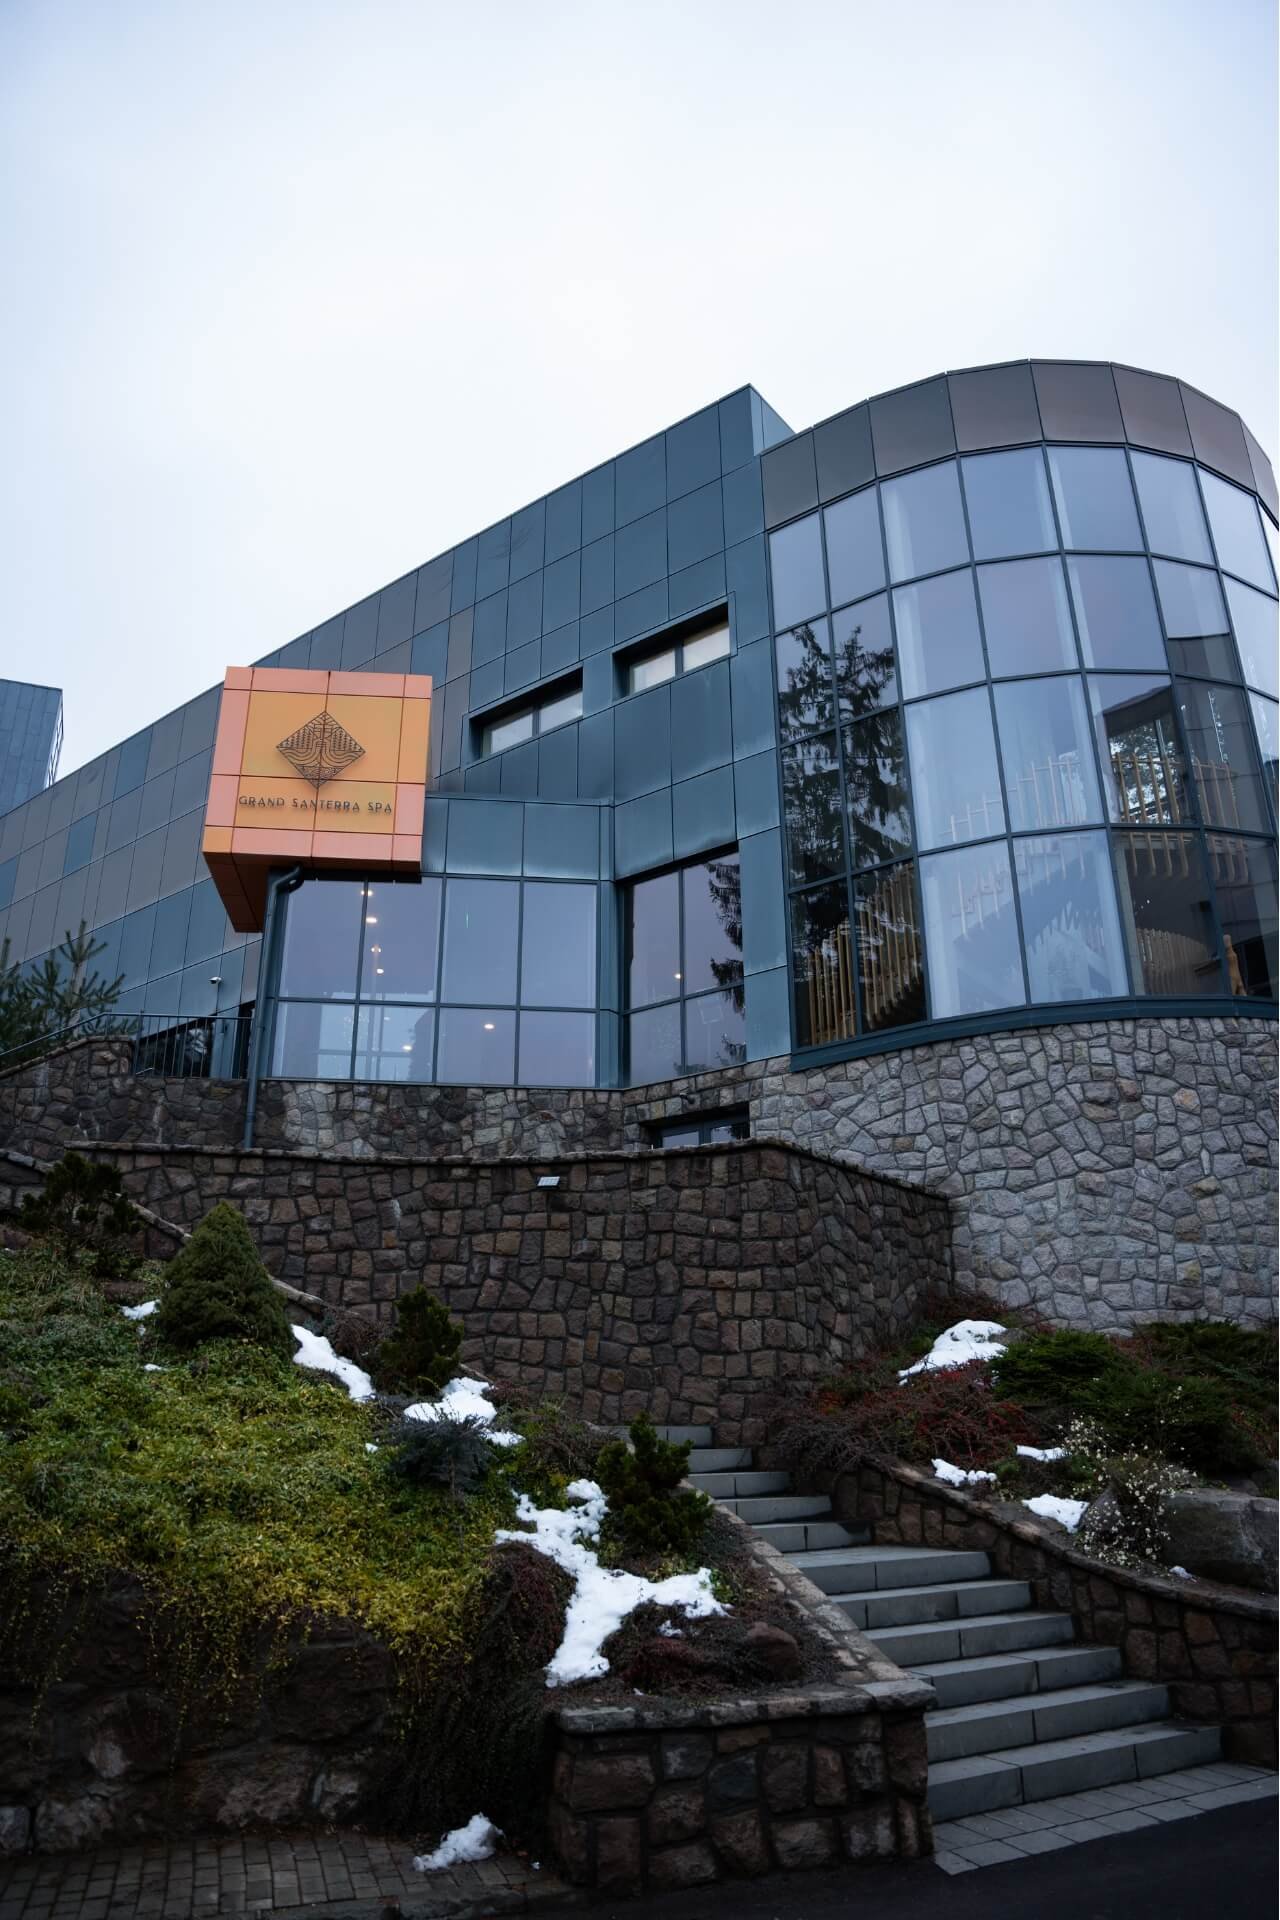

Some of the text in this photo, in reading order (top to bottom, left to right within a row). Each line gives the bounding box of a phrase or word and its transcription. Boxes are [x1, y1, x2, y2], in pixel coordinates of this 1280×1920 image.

[239, 795, 392, 814] GRAND SANTERRA SPA
